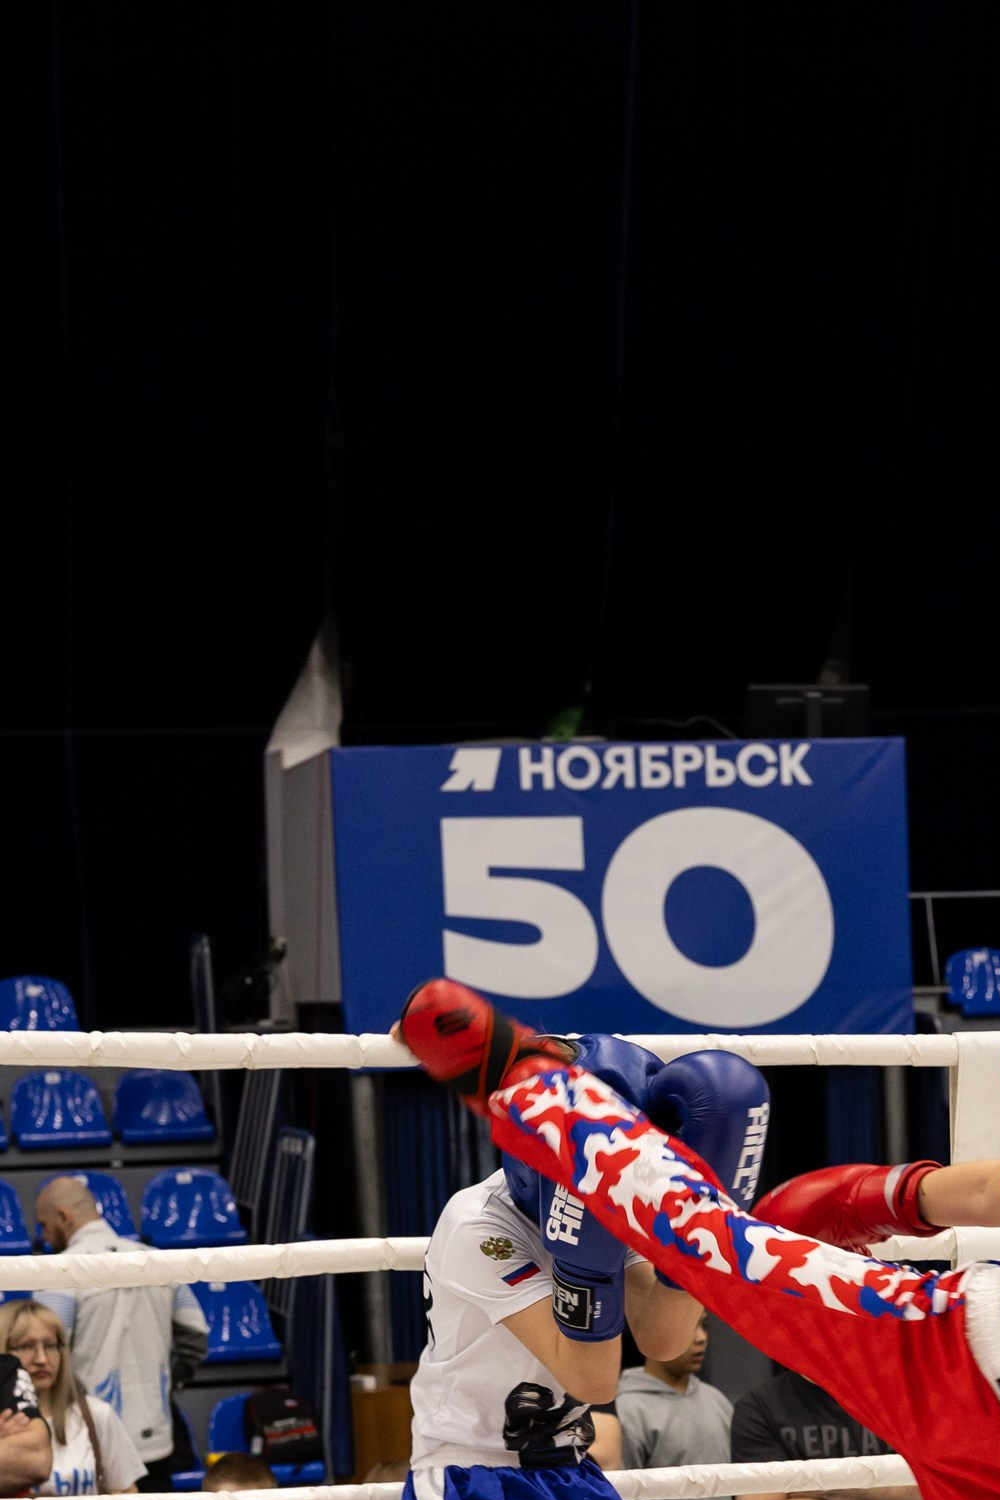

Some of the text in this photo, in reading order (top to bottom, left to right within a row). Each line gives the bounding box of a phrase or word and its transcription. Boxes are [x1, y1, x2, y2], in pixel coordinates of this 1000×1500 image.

[518, 743, 813, 790] НОЯБРЬСК
[440, 806, 835, 1028] 50
[545, 1182, 569, 1242] GRE
[558, 1193, 586, 1246] HI
[780, 1424, 883, 1457] REPLA
